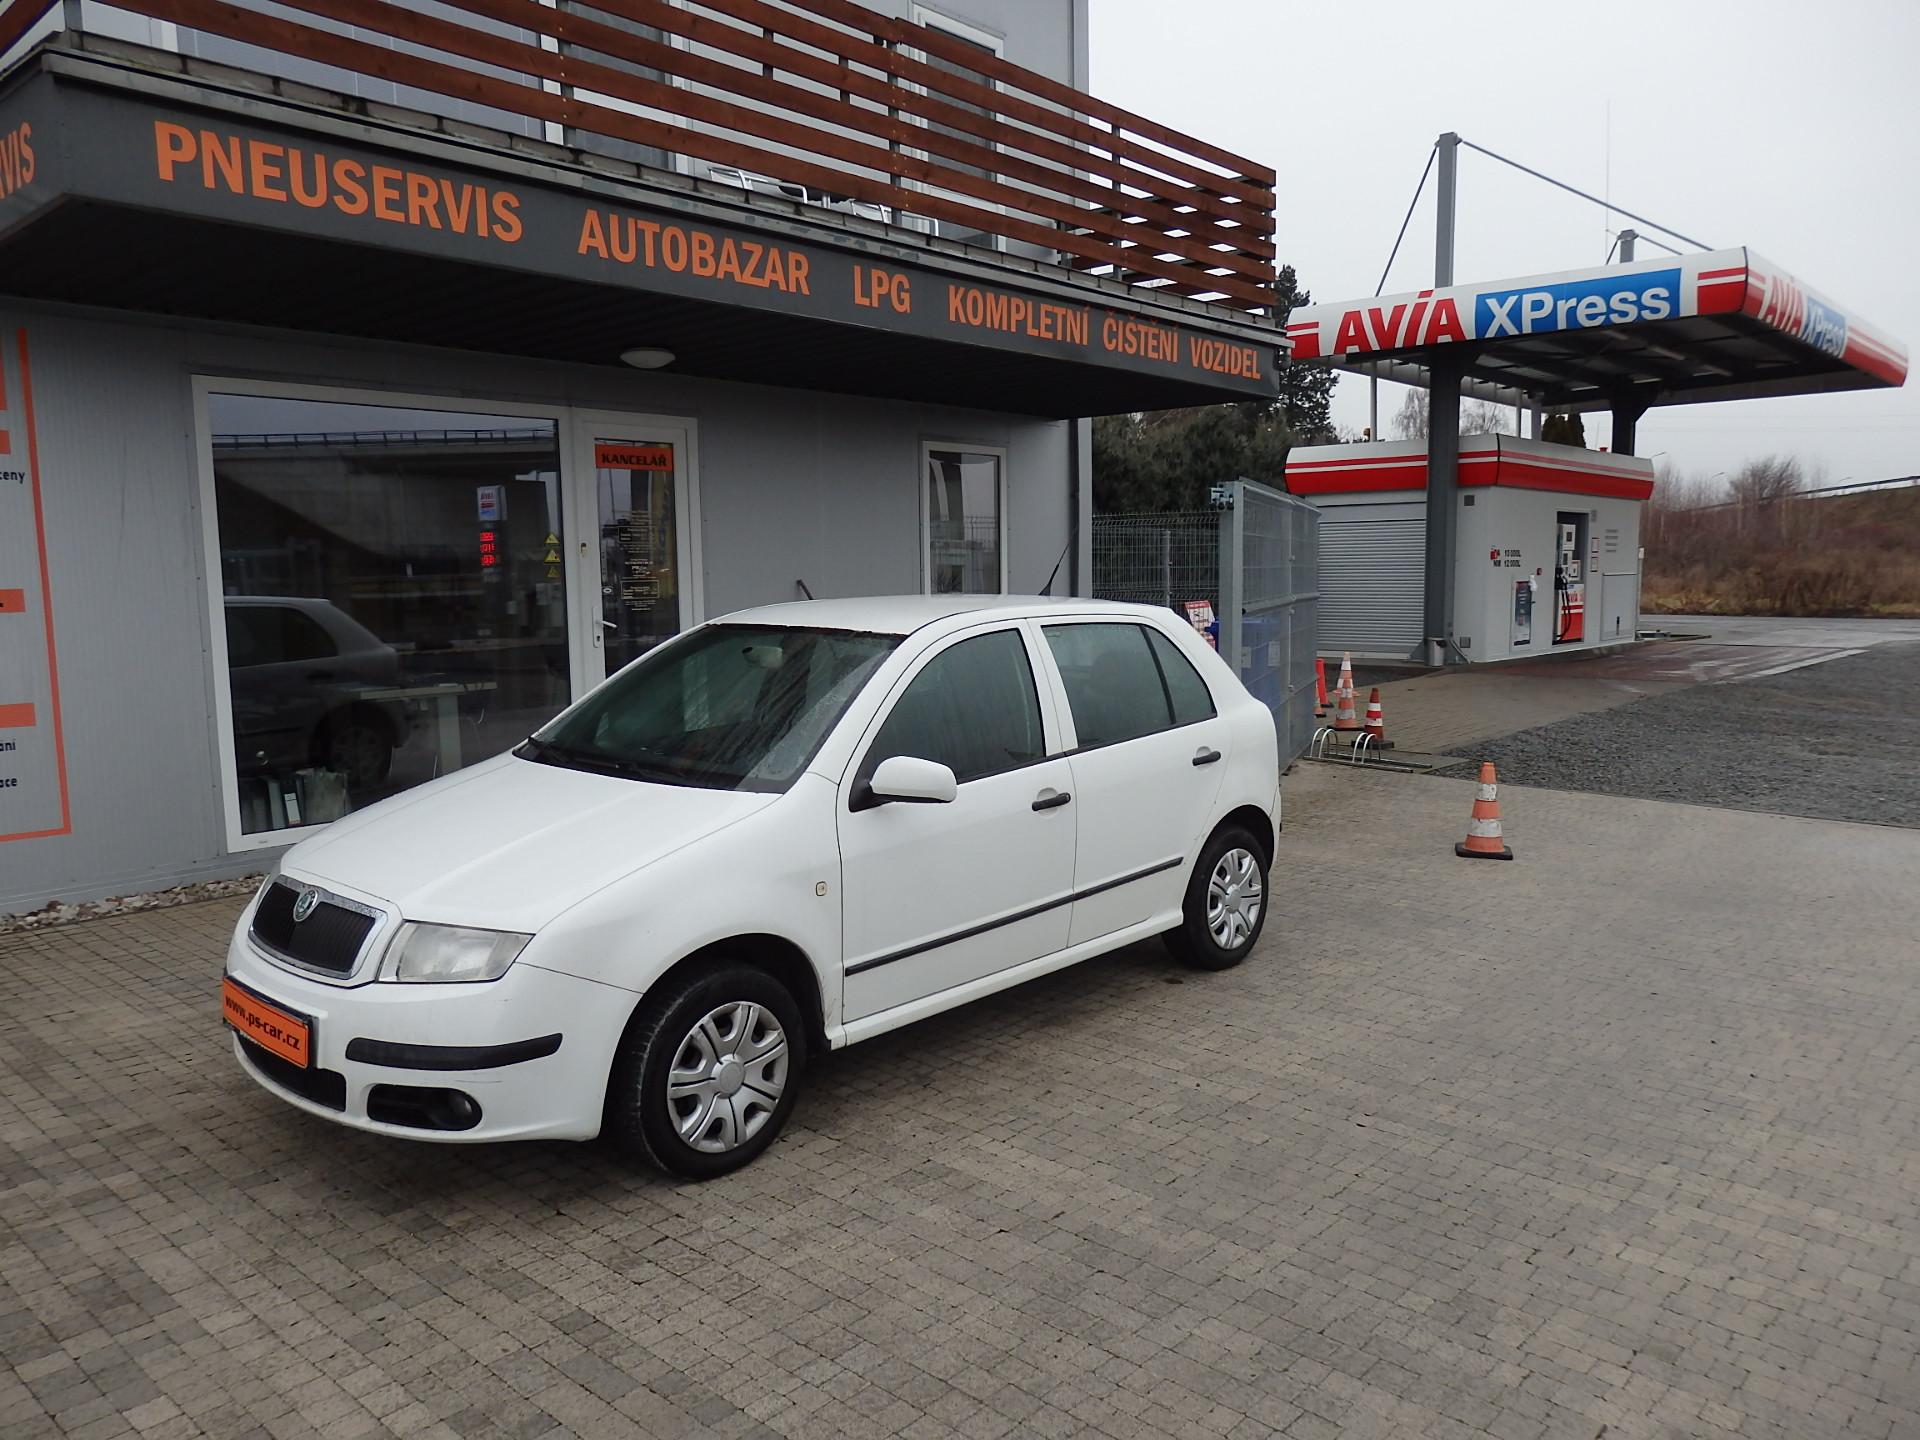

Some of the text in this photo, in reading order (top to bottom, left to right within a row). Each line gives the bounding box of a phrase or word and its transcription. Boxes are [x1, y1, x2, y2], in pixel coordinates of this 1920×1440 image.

[154, 120, 1261, 380] PNEUSERVIS AUTOBAZAR LPG KOMPLETNÍ ČIŠTĚNÍ VOZIDEL
[1334, 287, 1670, 354] AVIA XPress
[1802, 300, 1843, 357] XPress
[601, 453, 667, 467] KANCELÁŘ
[225, 995, 300, 1050] www.ps-car.cz
